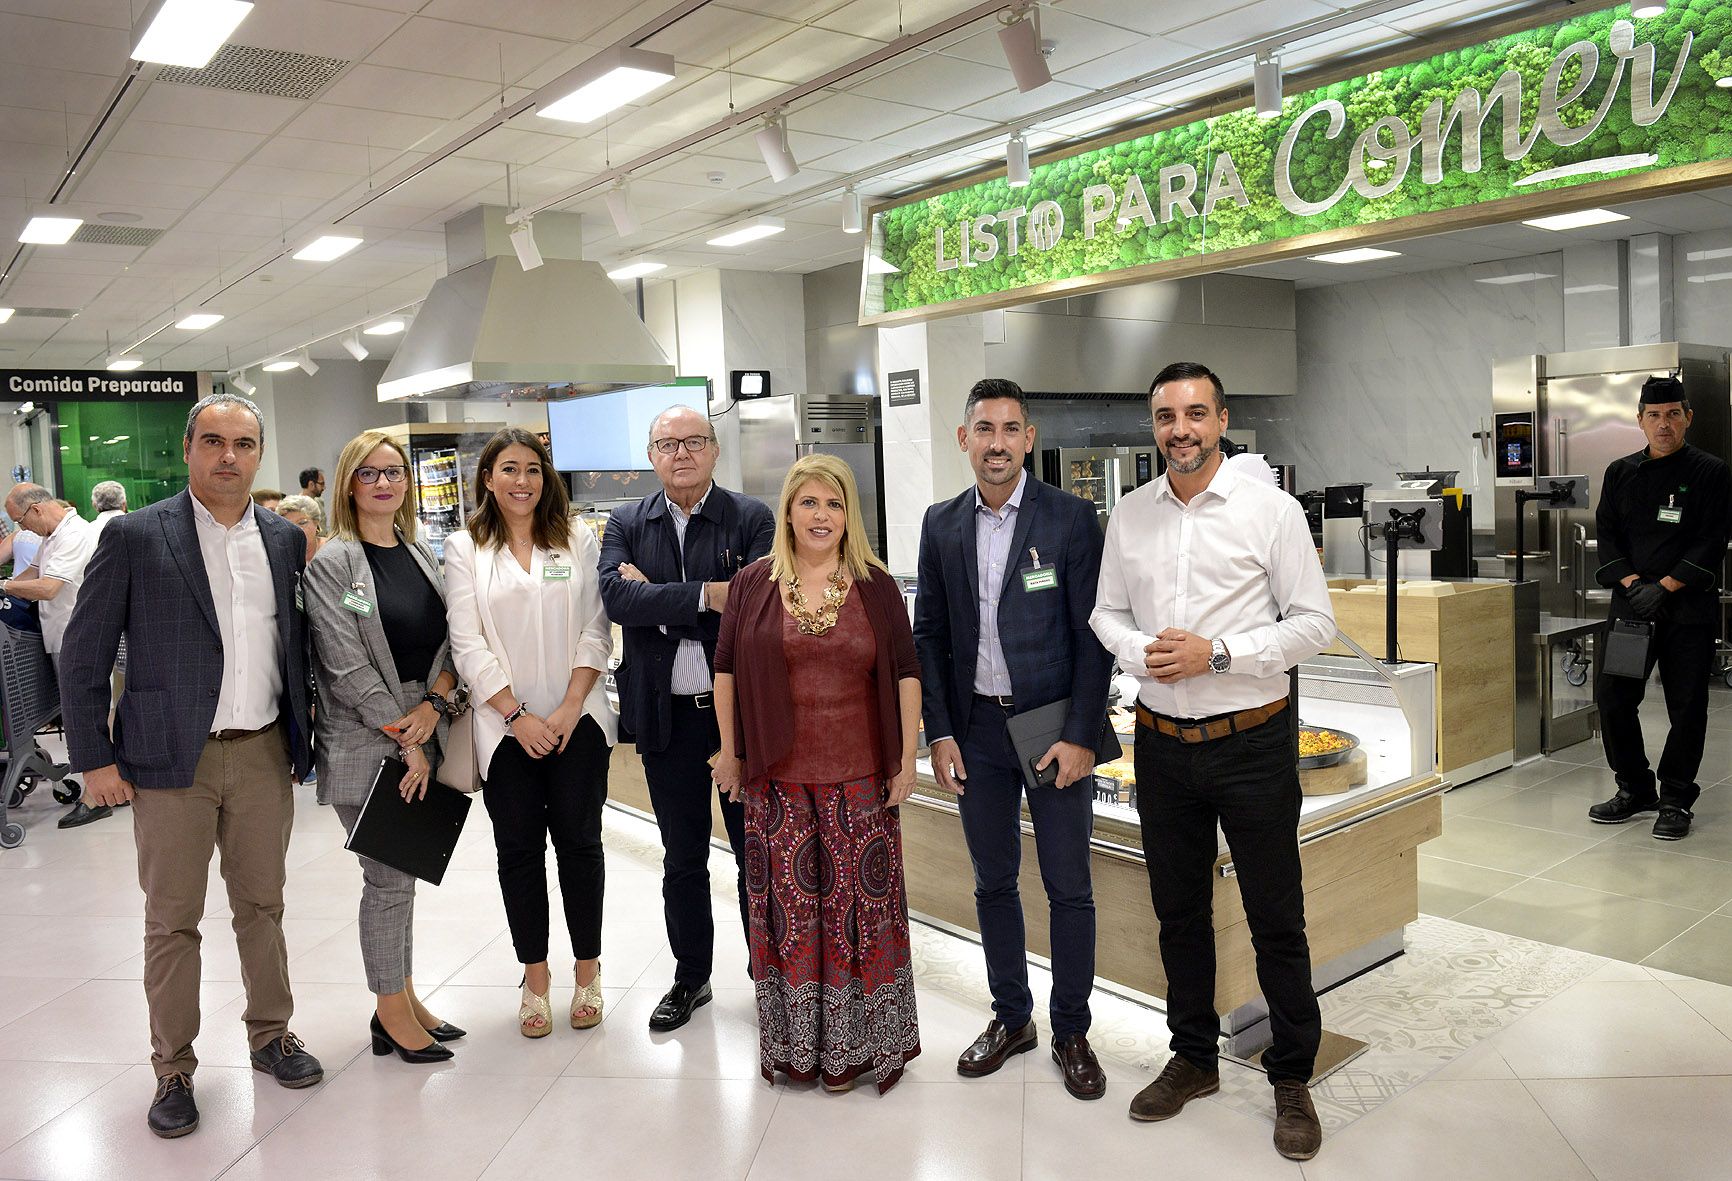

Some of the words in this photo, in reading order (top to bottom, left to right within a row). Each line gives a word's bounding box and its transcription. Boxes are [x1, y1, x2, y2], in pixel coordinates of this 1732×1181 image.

[935, 200, 1064, 272] LISTO
[1083, 151, 1250, 240] PARA
[1274, 20, 1694, 217] Comer
[9, 376, 83, 392] Comida
[87, 376, 184, 396] Preparada
